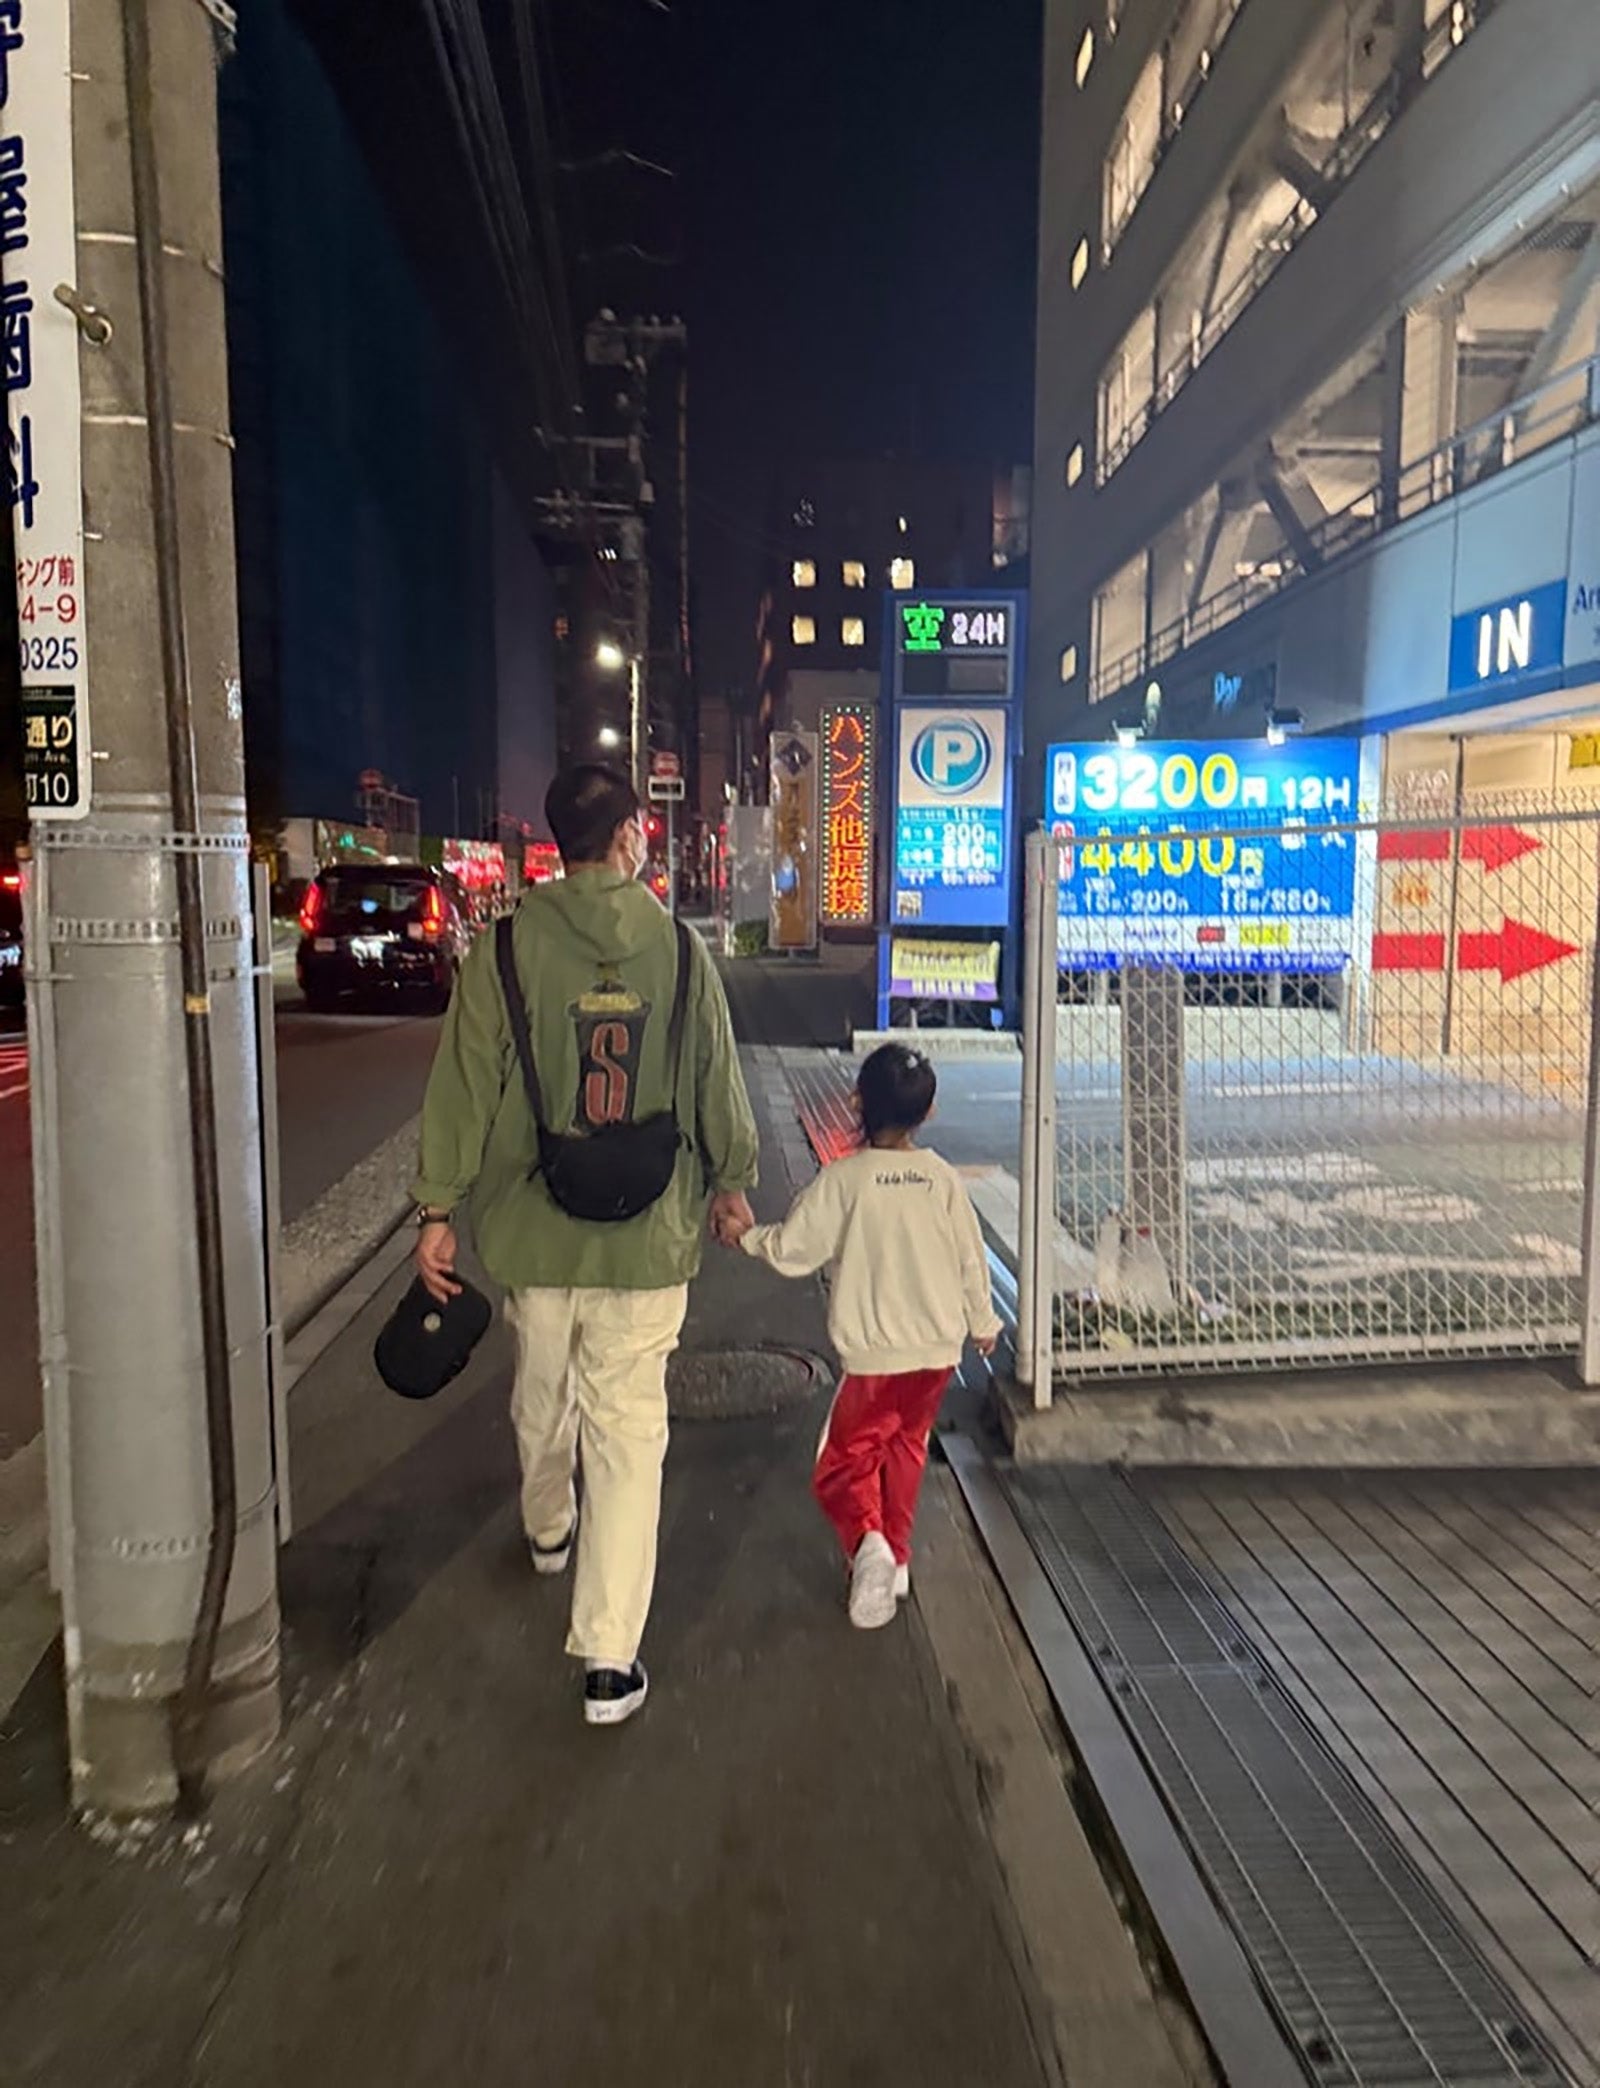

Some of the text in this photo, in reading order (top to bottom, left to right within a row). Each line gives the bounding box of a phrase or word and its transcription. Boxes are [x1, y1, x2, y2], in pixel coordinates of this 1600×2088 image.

[903, 602, 1005, 650] 空 24H
[1478, 600, 1532, 679] IN
[932, 729, 977, 783] P
[828, 716, 865, 914] ハンズ他提携
[1281, 776, 1351, 811] 12H
[585, 1022, 629, 1125] S
